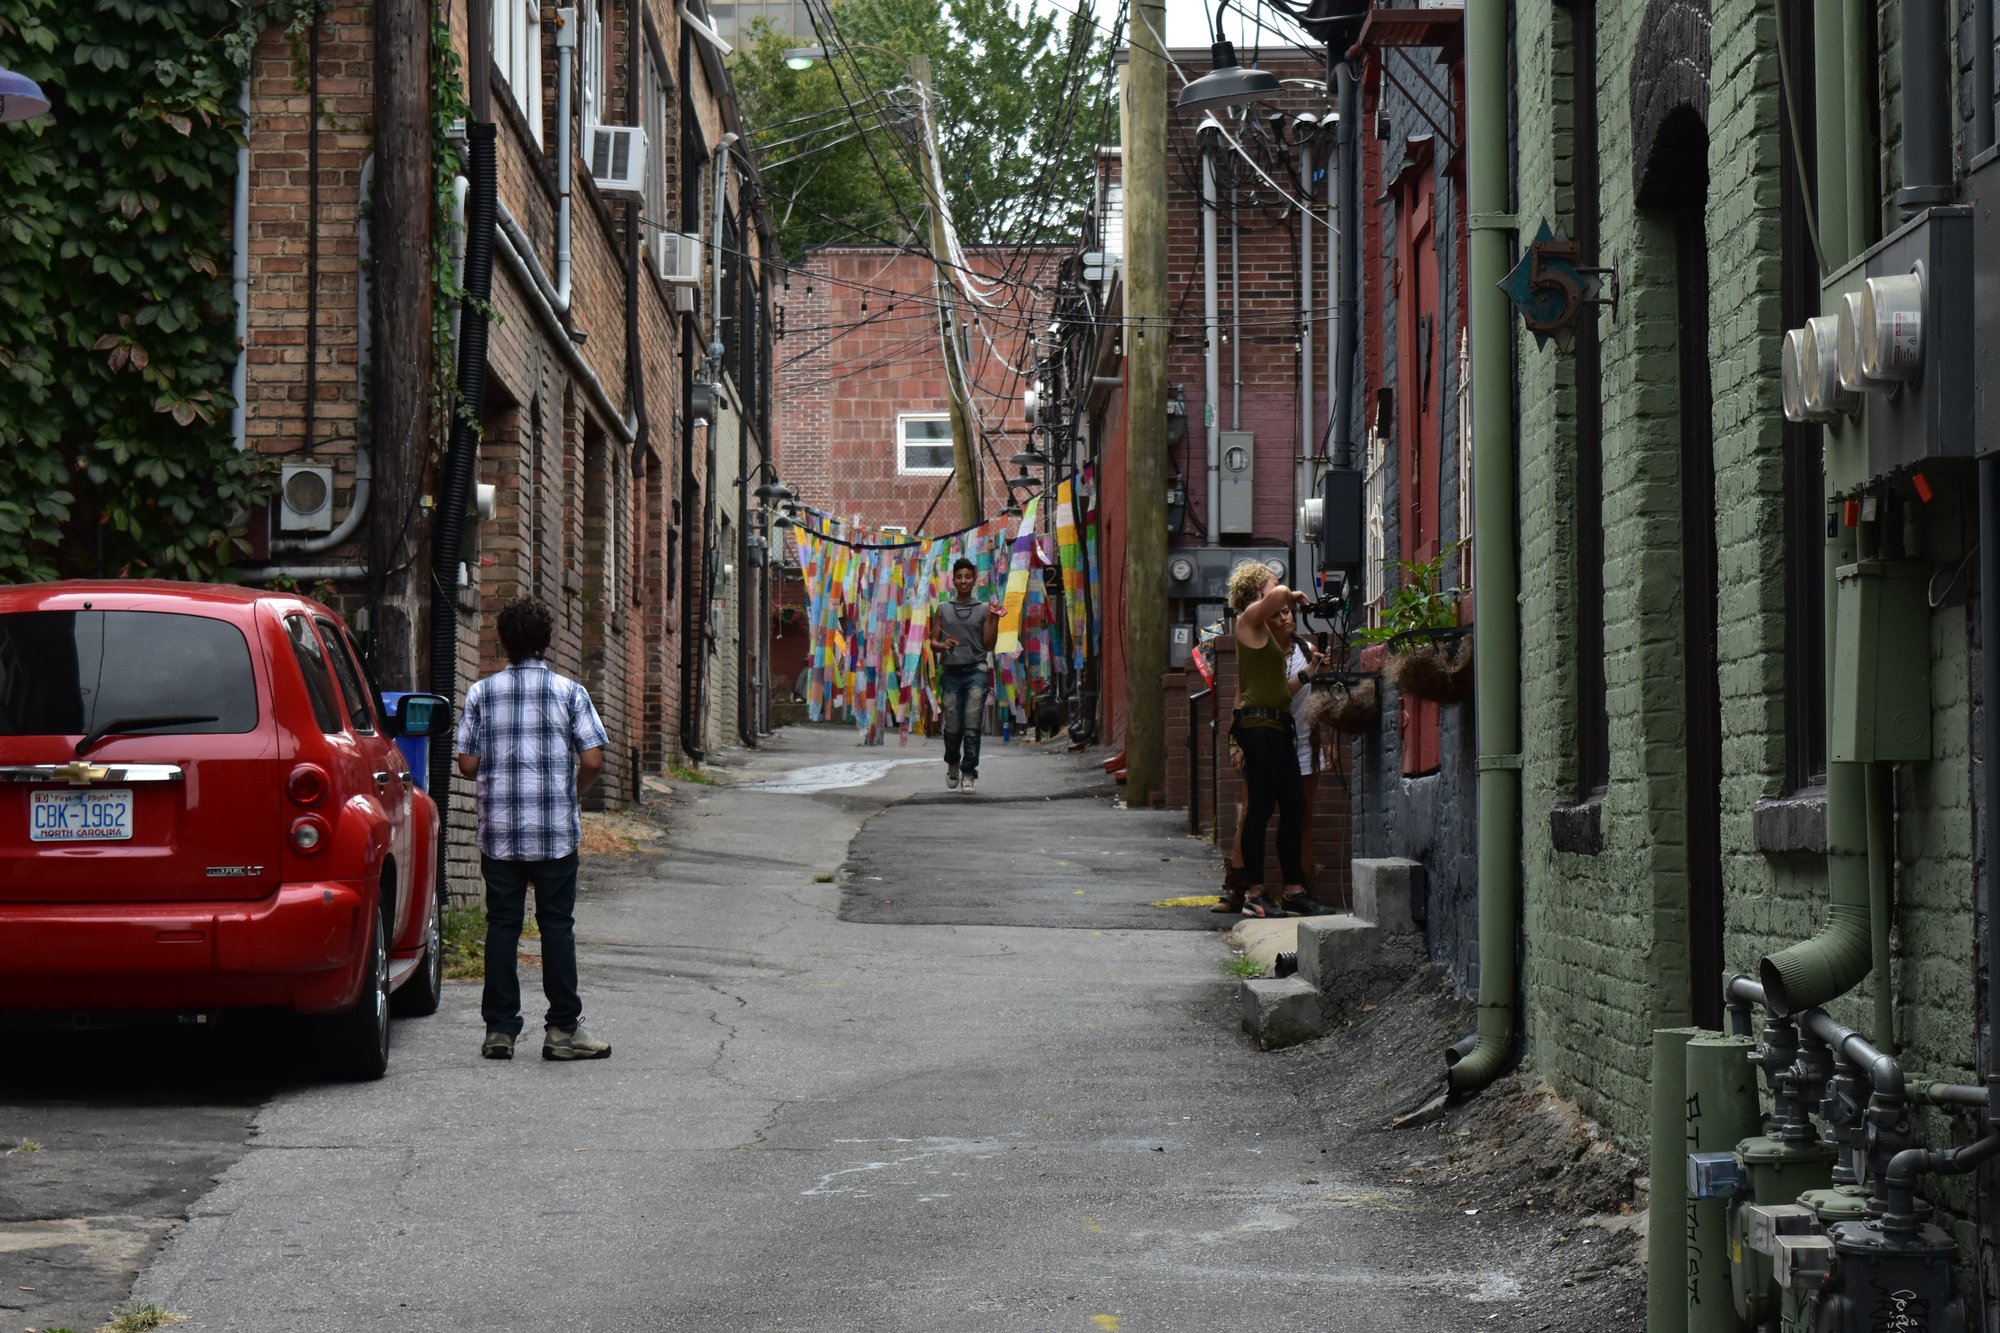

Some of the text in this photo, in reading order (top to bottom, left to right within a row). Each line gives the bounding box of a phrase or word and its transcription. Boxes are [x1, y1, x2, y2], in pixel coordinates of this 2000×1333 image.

[1523, 241, 1581, 331] 5
[1045, 567, 1058, 587] 2
[35, 803, 126, 828] CBK-1962
[41, 828, 122, 837] NORTH CAROLINA
[247, 866, 264, 876] LT
